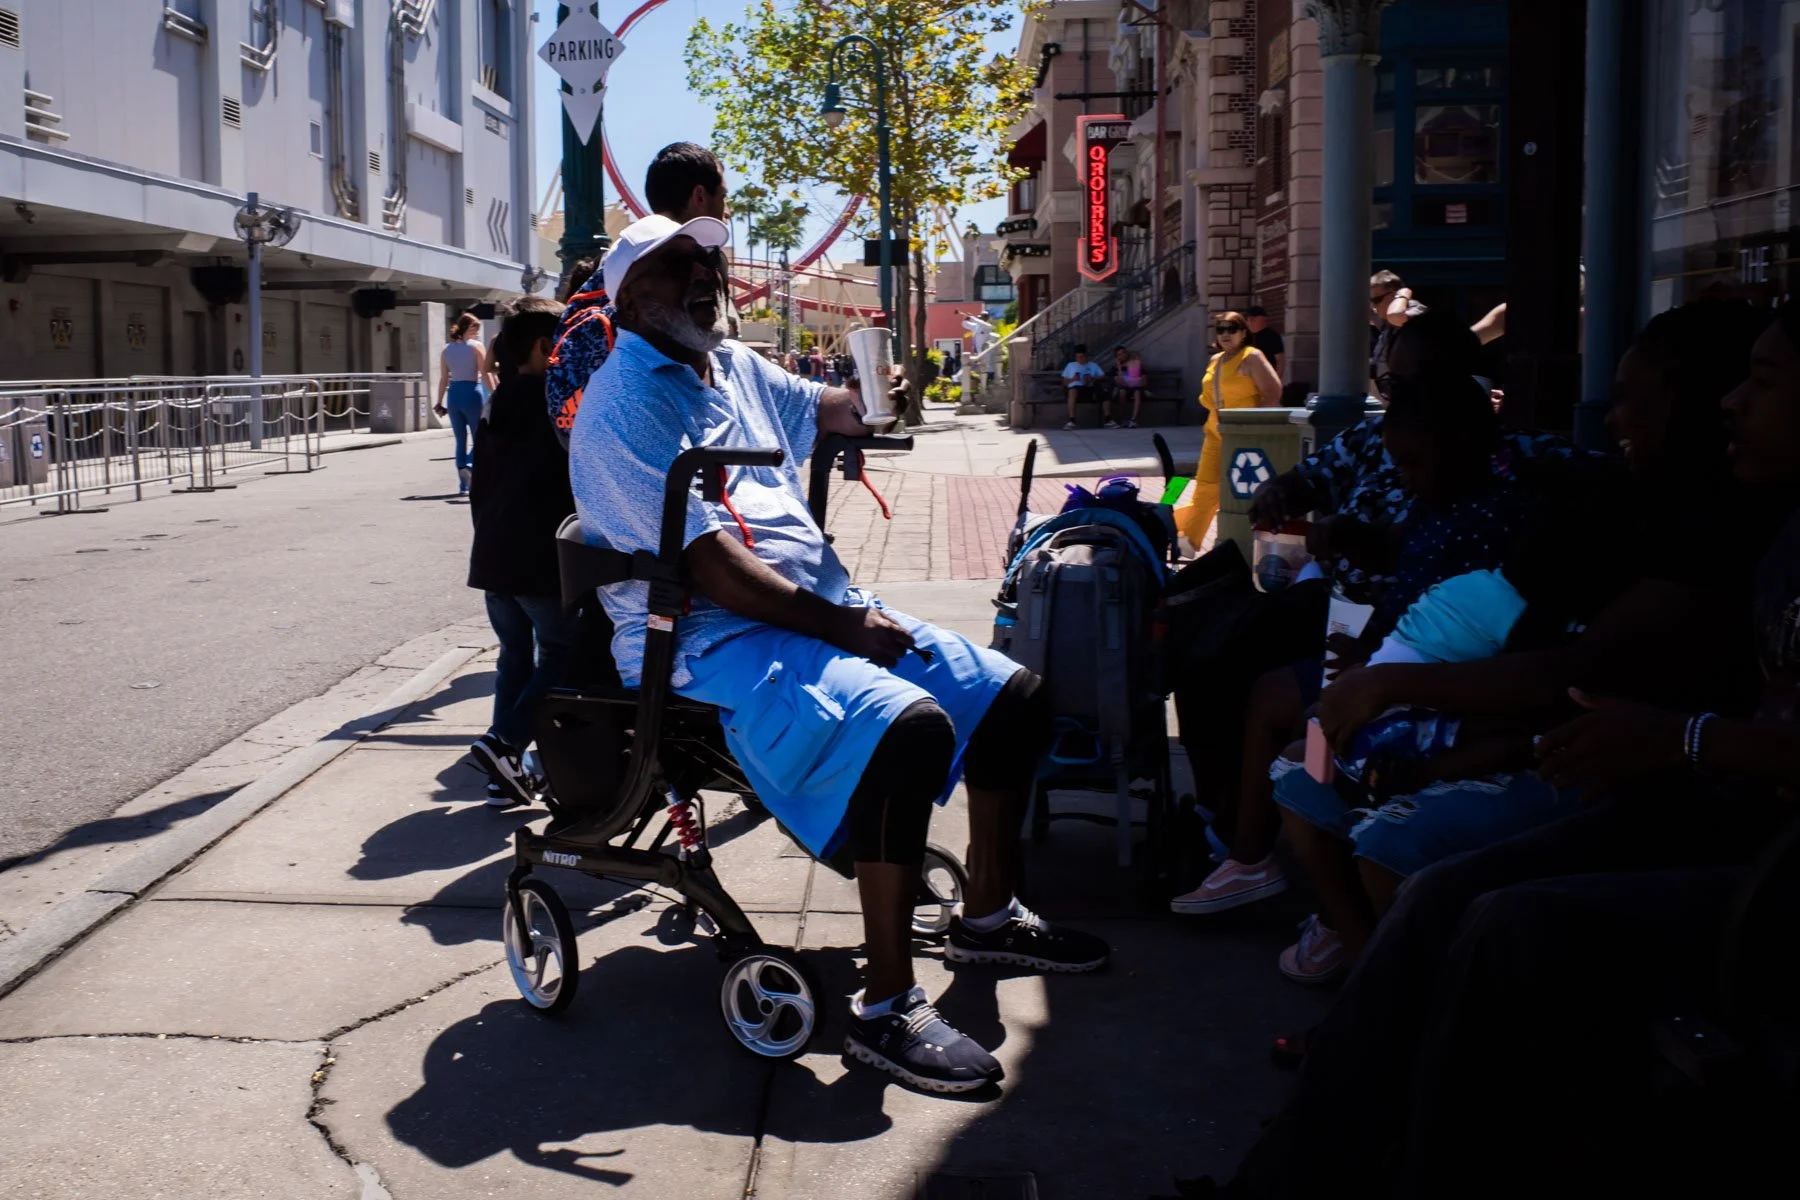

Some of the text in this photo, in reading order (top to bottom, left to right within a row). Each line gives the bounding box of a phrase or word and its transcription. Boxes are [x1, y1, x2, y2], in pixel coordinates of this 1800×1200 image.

[548, 39, 614, 62] PARKING
[1087, 126, 1107, 139] BAR
[543, 850, 577, 867] NITRO
